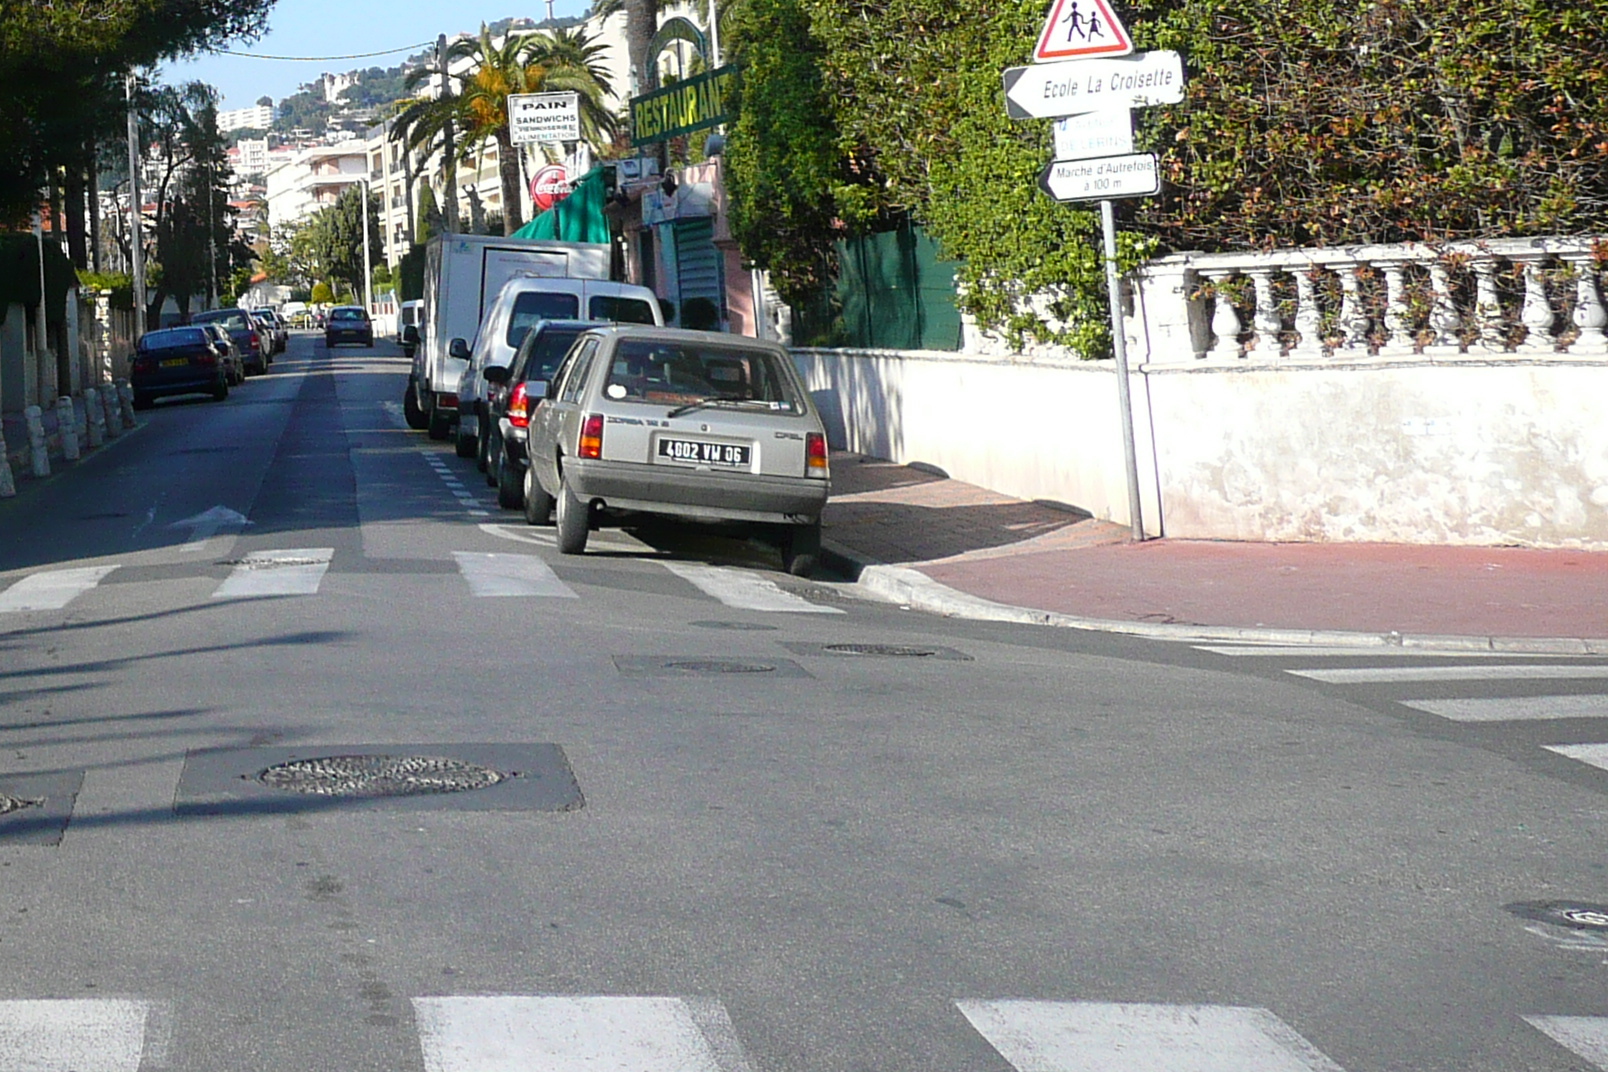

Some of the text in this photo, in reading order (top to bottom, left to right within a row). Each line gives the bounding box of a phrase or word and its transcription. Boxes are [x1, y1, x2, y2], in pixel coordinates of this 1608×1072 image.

[1043, 67, 1173, 99] Ecole La Croisette
[522, 101, 567, 111] PAIN
[515, 114, 576, 125] SANDWICHS
[517, 131, 576, 141] ALIMENTATION
[1060, 135, 1127, 153] DE LERINS
[1056, 159, 1153, 179] Marché d'Autrefois
[1084, 177, 1122, 190] à 100 m
[703, 444, 721, 460] VW
[725, 446, 742, 462] 06
